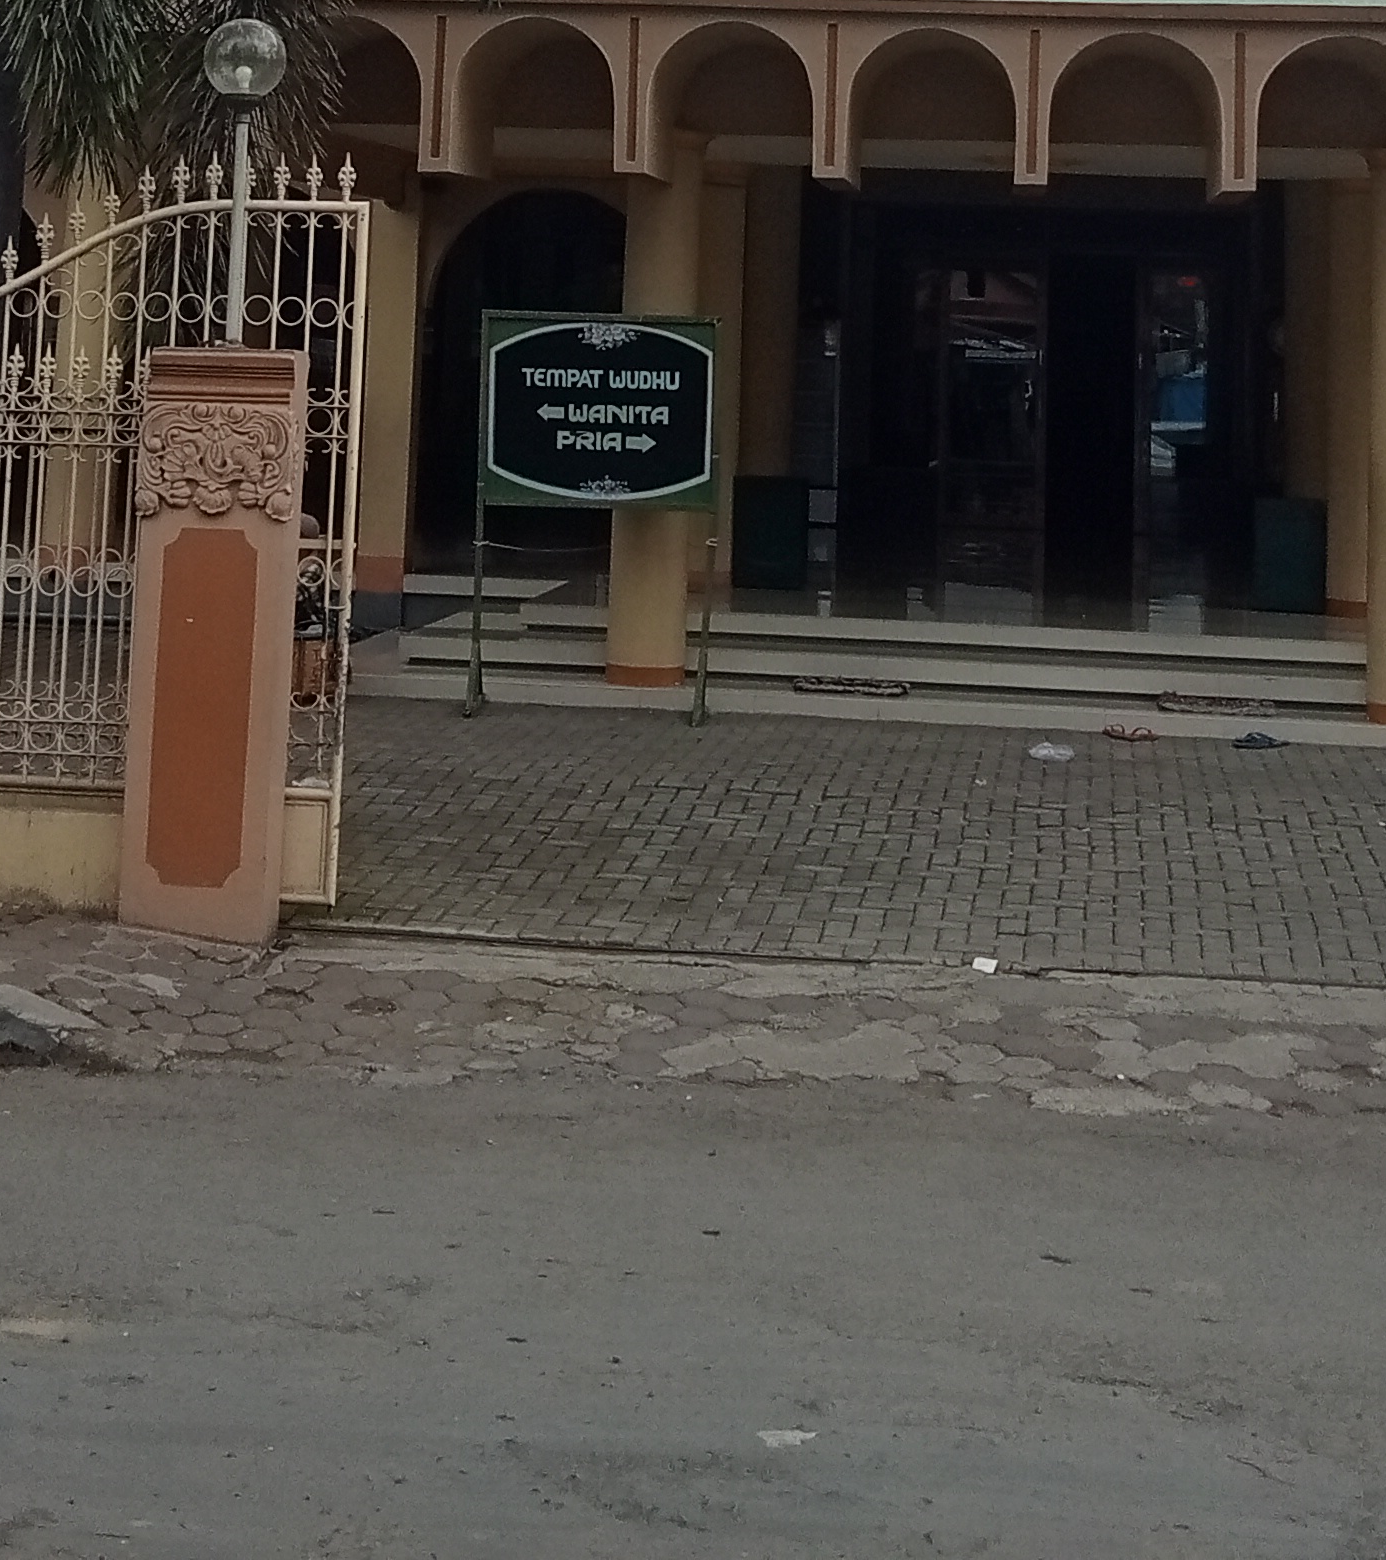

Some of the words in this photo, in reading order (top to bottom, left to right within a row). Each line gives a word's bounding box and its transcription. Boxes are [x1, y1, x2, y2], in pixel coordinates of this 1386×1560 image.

[521, 367, 604, 389] TEMPAT
[609, 369, 680, 391] WUDHU
[568, 403, 669, 425] WANITA
[556, 430, 622, 452] PRIA
